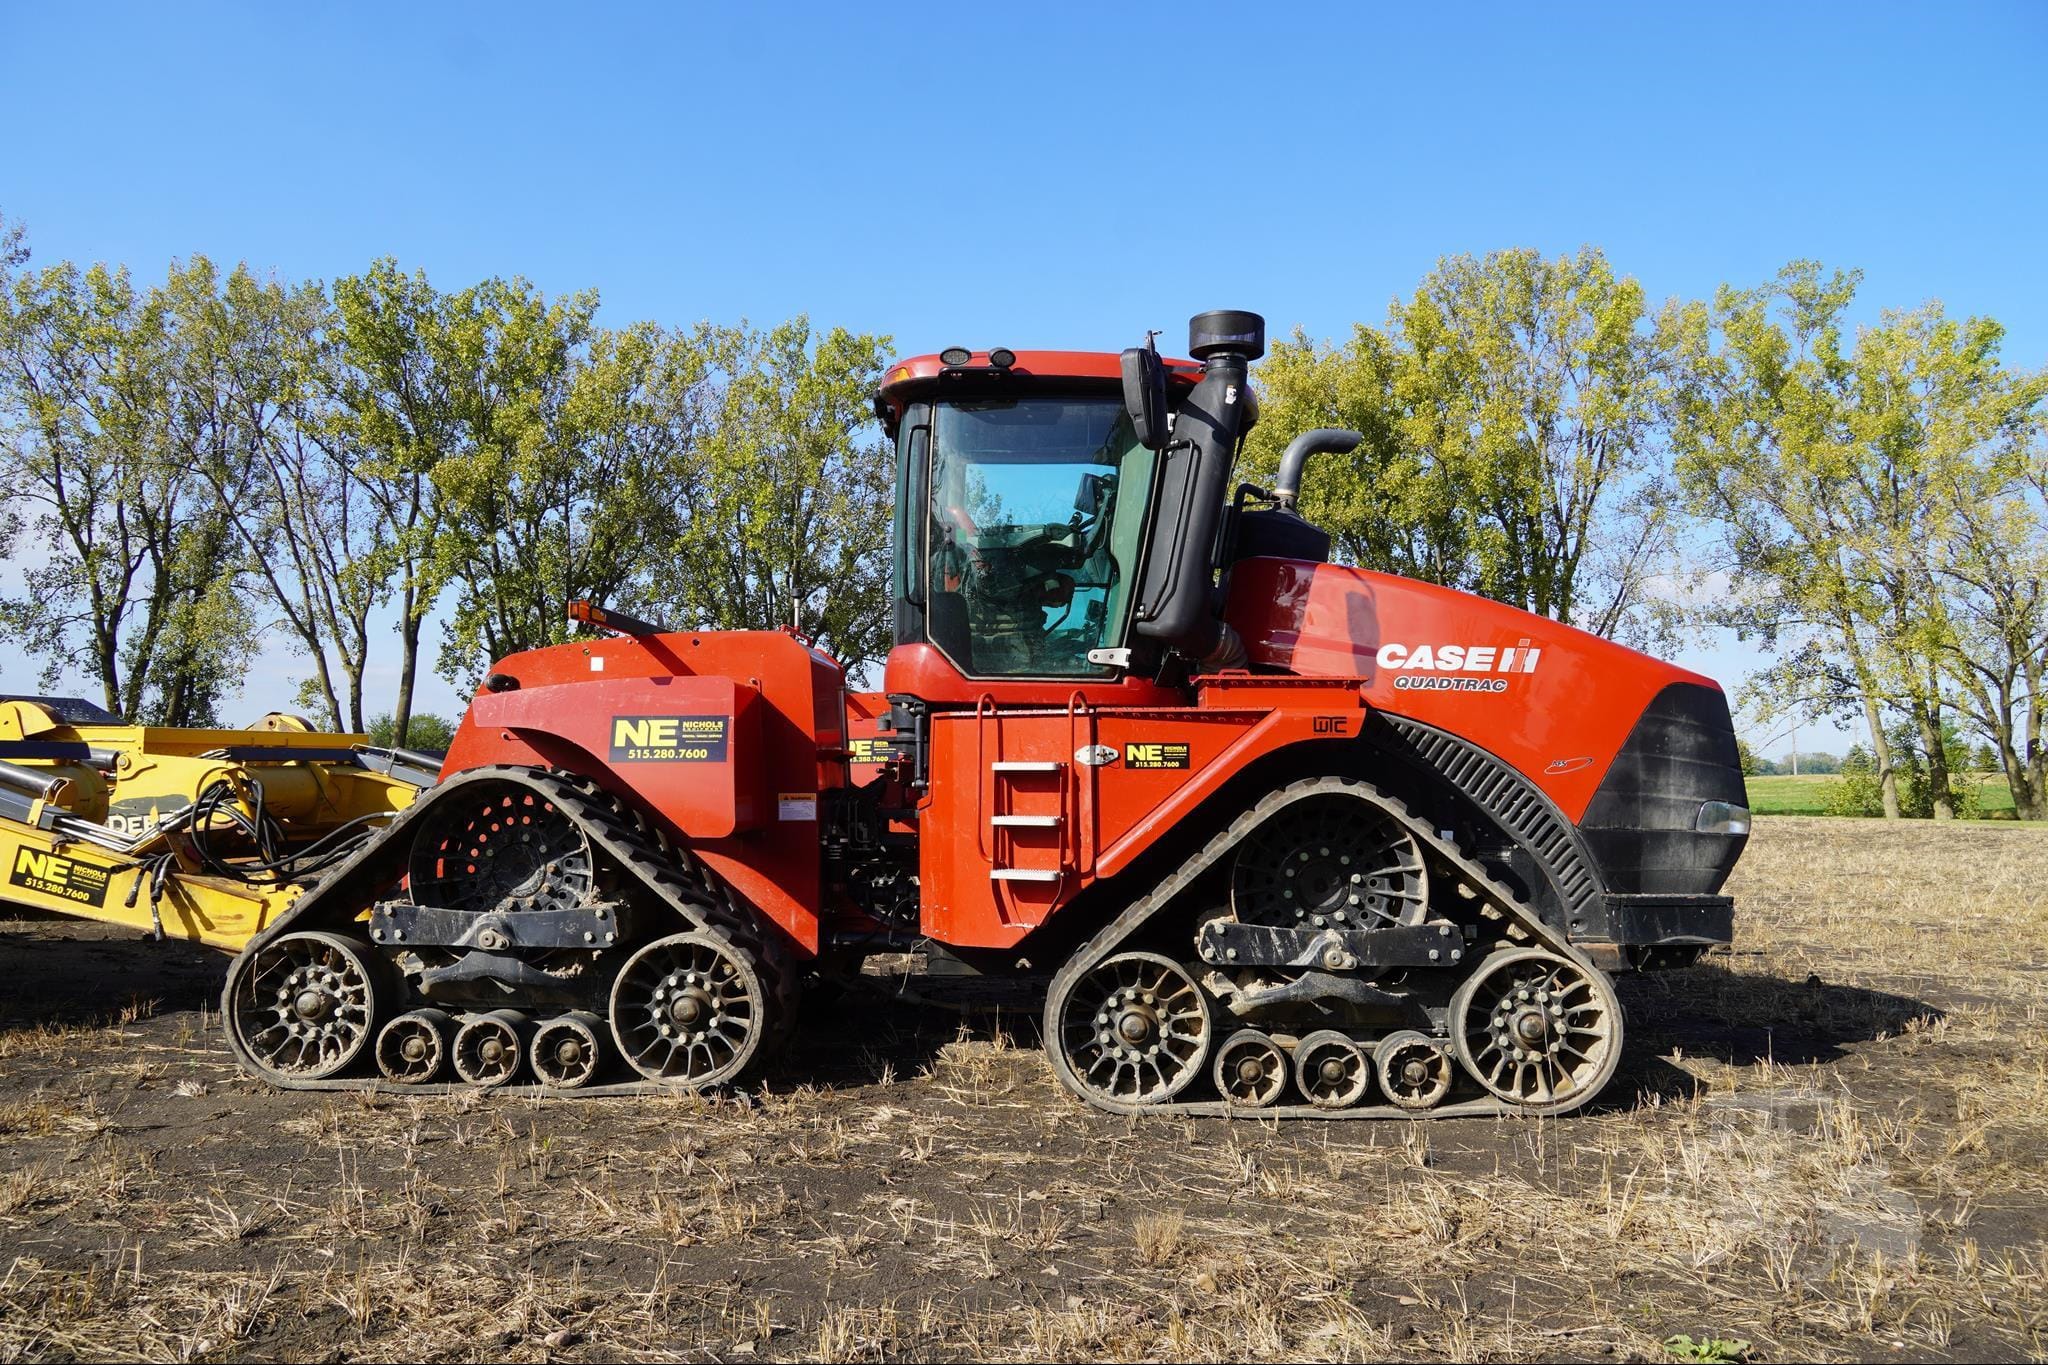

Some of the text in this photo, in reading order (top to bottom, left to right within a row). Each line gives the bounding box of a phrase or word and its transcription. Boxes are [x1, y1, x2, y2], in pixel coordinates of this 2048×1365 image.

[1376, 643, 1496, 671] CASE
[1394, 675, 1508, 692] QUADTRAC
[614, 719, 679, 747] NE
[682, 721, 723, 729] NICHOLS
[628, 748, 708, 759] 515.280.7600
[1127, 745, 1163, 761] NE
[16, 848, 72, 884] NE
[74, 864, 107, 878] NICHOLS
[25, 877, 90, 901] 515.280.7600
